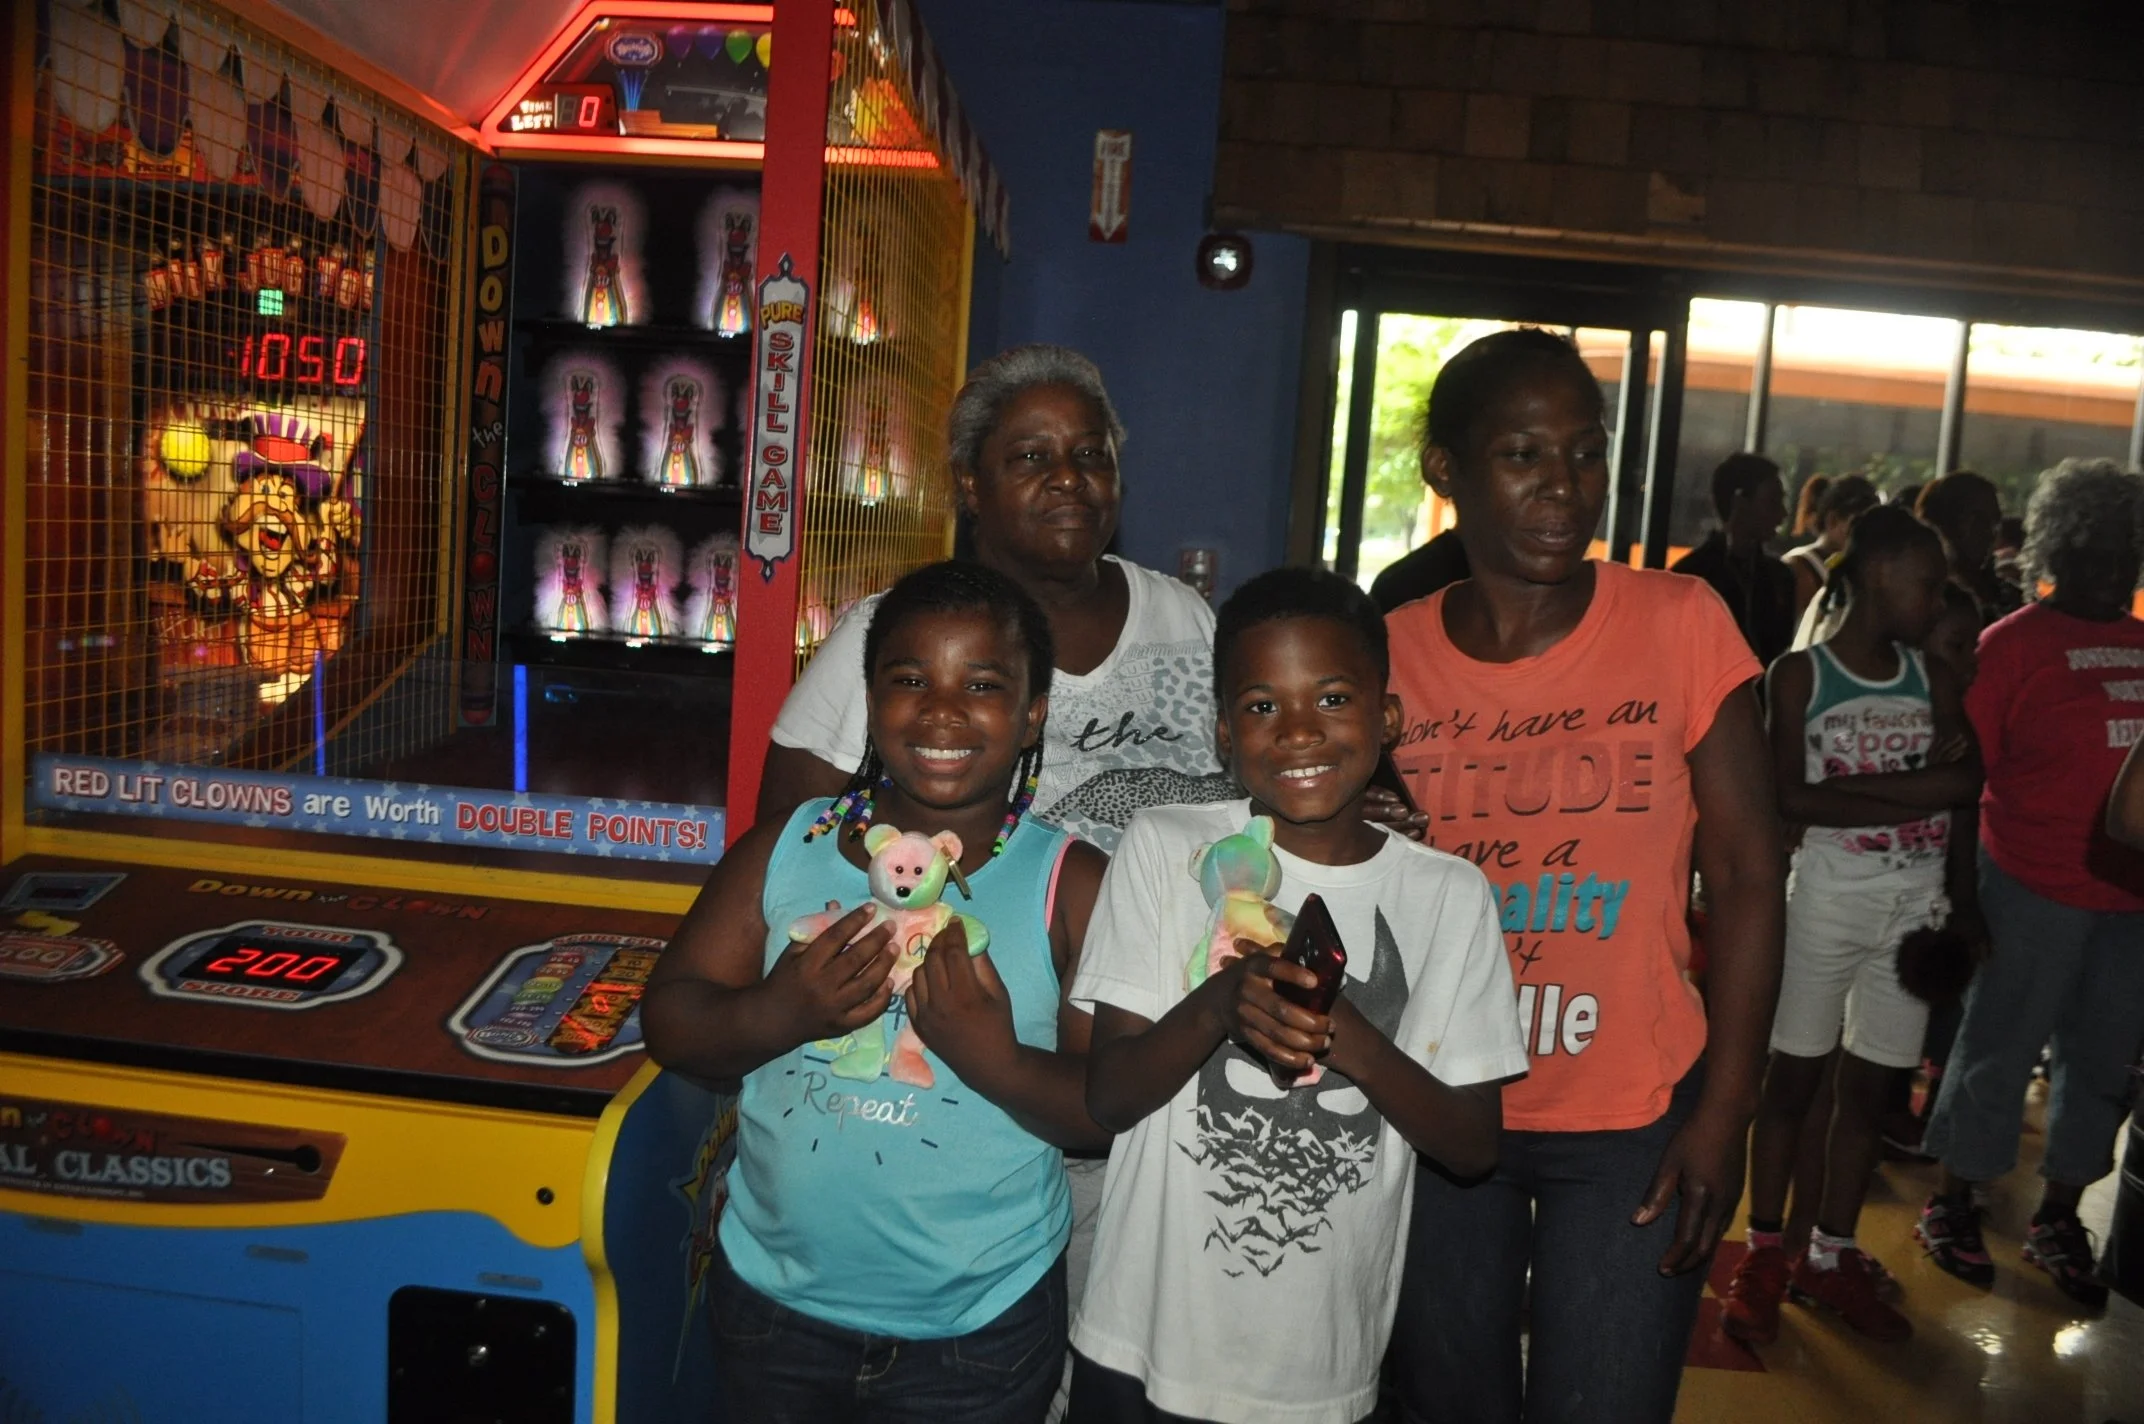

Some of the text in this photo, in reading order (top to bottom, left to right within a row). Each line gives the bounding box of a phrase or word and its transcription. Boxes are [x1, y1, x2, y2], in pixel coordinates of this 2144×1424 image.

[511, 115, 553, 131] LEFT
[520, 100, 552, 112] TIME
[760, 300, 805, 331] PURE
[241, 333, 366, 385] 1050
[756, 331, 794, 535] SKILL GAME
[1070, 711, 1184, 752] the
[1487, 707, 1587, 742] have
[1607, 700, 1658, 725] an
[1833, 731, 1933, 761] spor
[1400, 741, 1653, 821] TITUDE
[54, 767, 708, 850] RED LIT CLOWNS are Worth DOUBLE POINTS!
[1431, 836, 1582, 868] ave a
[1491, 872, 1630, 940] ality
[263, 926, 354, 943] YOUR
[205, 948, 341, 981] 200
[178, 980, 303, 1002] SCORE
[803, 1071, 919, 1131] Repeat
[0, 1143, 37, 1174] AL
[54, 1150, 233, 1188] CLASSICS
